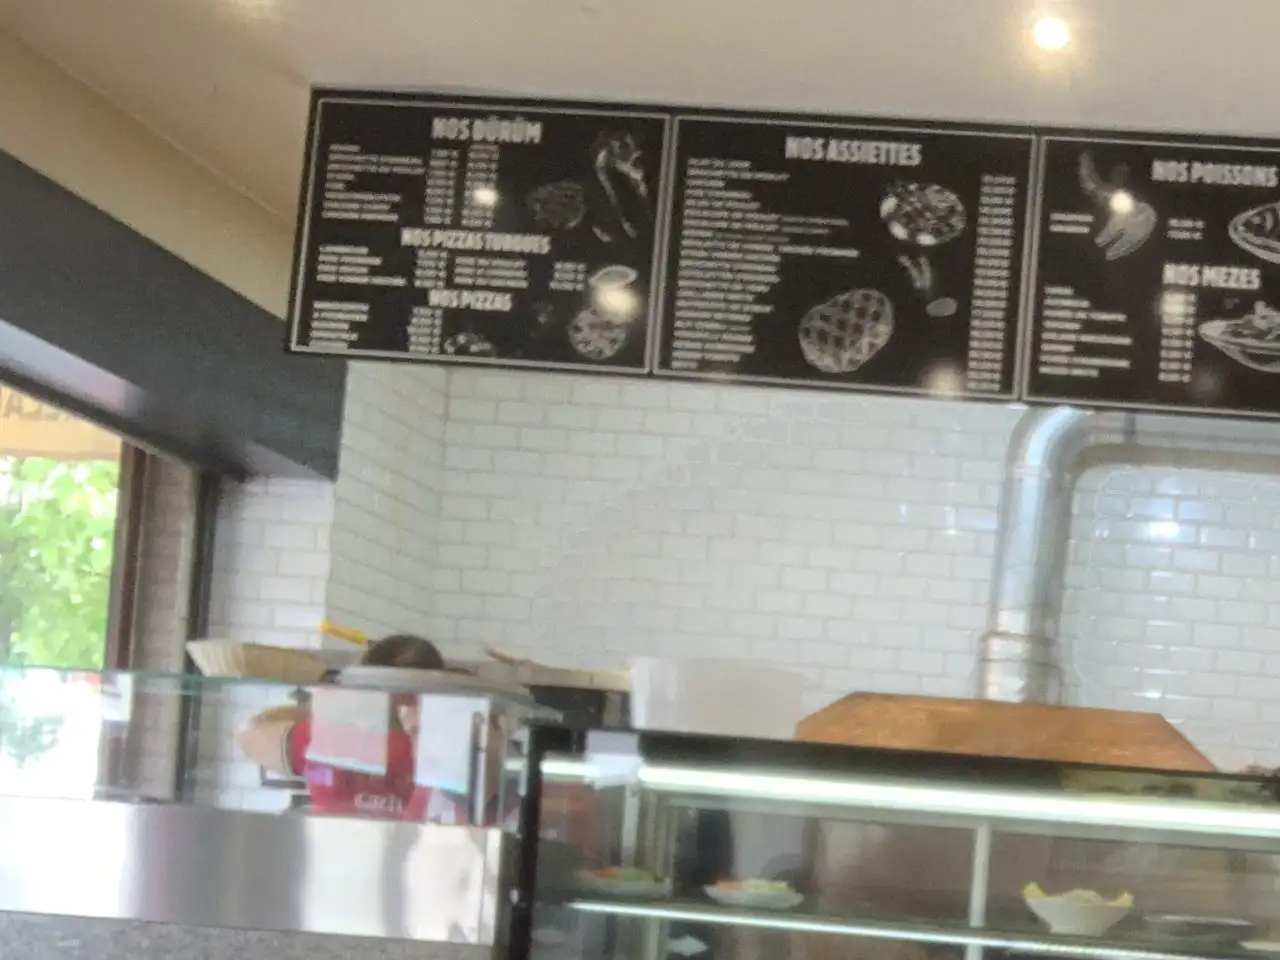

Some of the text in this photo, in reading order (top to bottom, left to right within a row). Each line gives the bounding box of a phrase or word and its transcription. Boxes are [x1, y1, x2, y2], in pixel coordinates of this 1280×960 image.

[431, 117, 470, 140] NOS
[785, 136, 922, 166] NOS ASSIETTES
[1152, 159, 1279, 188] NOS POISSONS
[401, 227, 431, 248] NOS
[432, 229, 484, 250] PIZZAS
[1162, 263, 1199, 286] NOS
[428, 289, 512, 312] NOS PIZZAS
